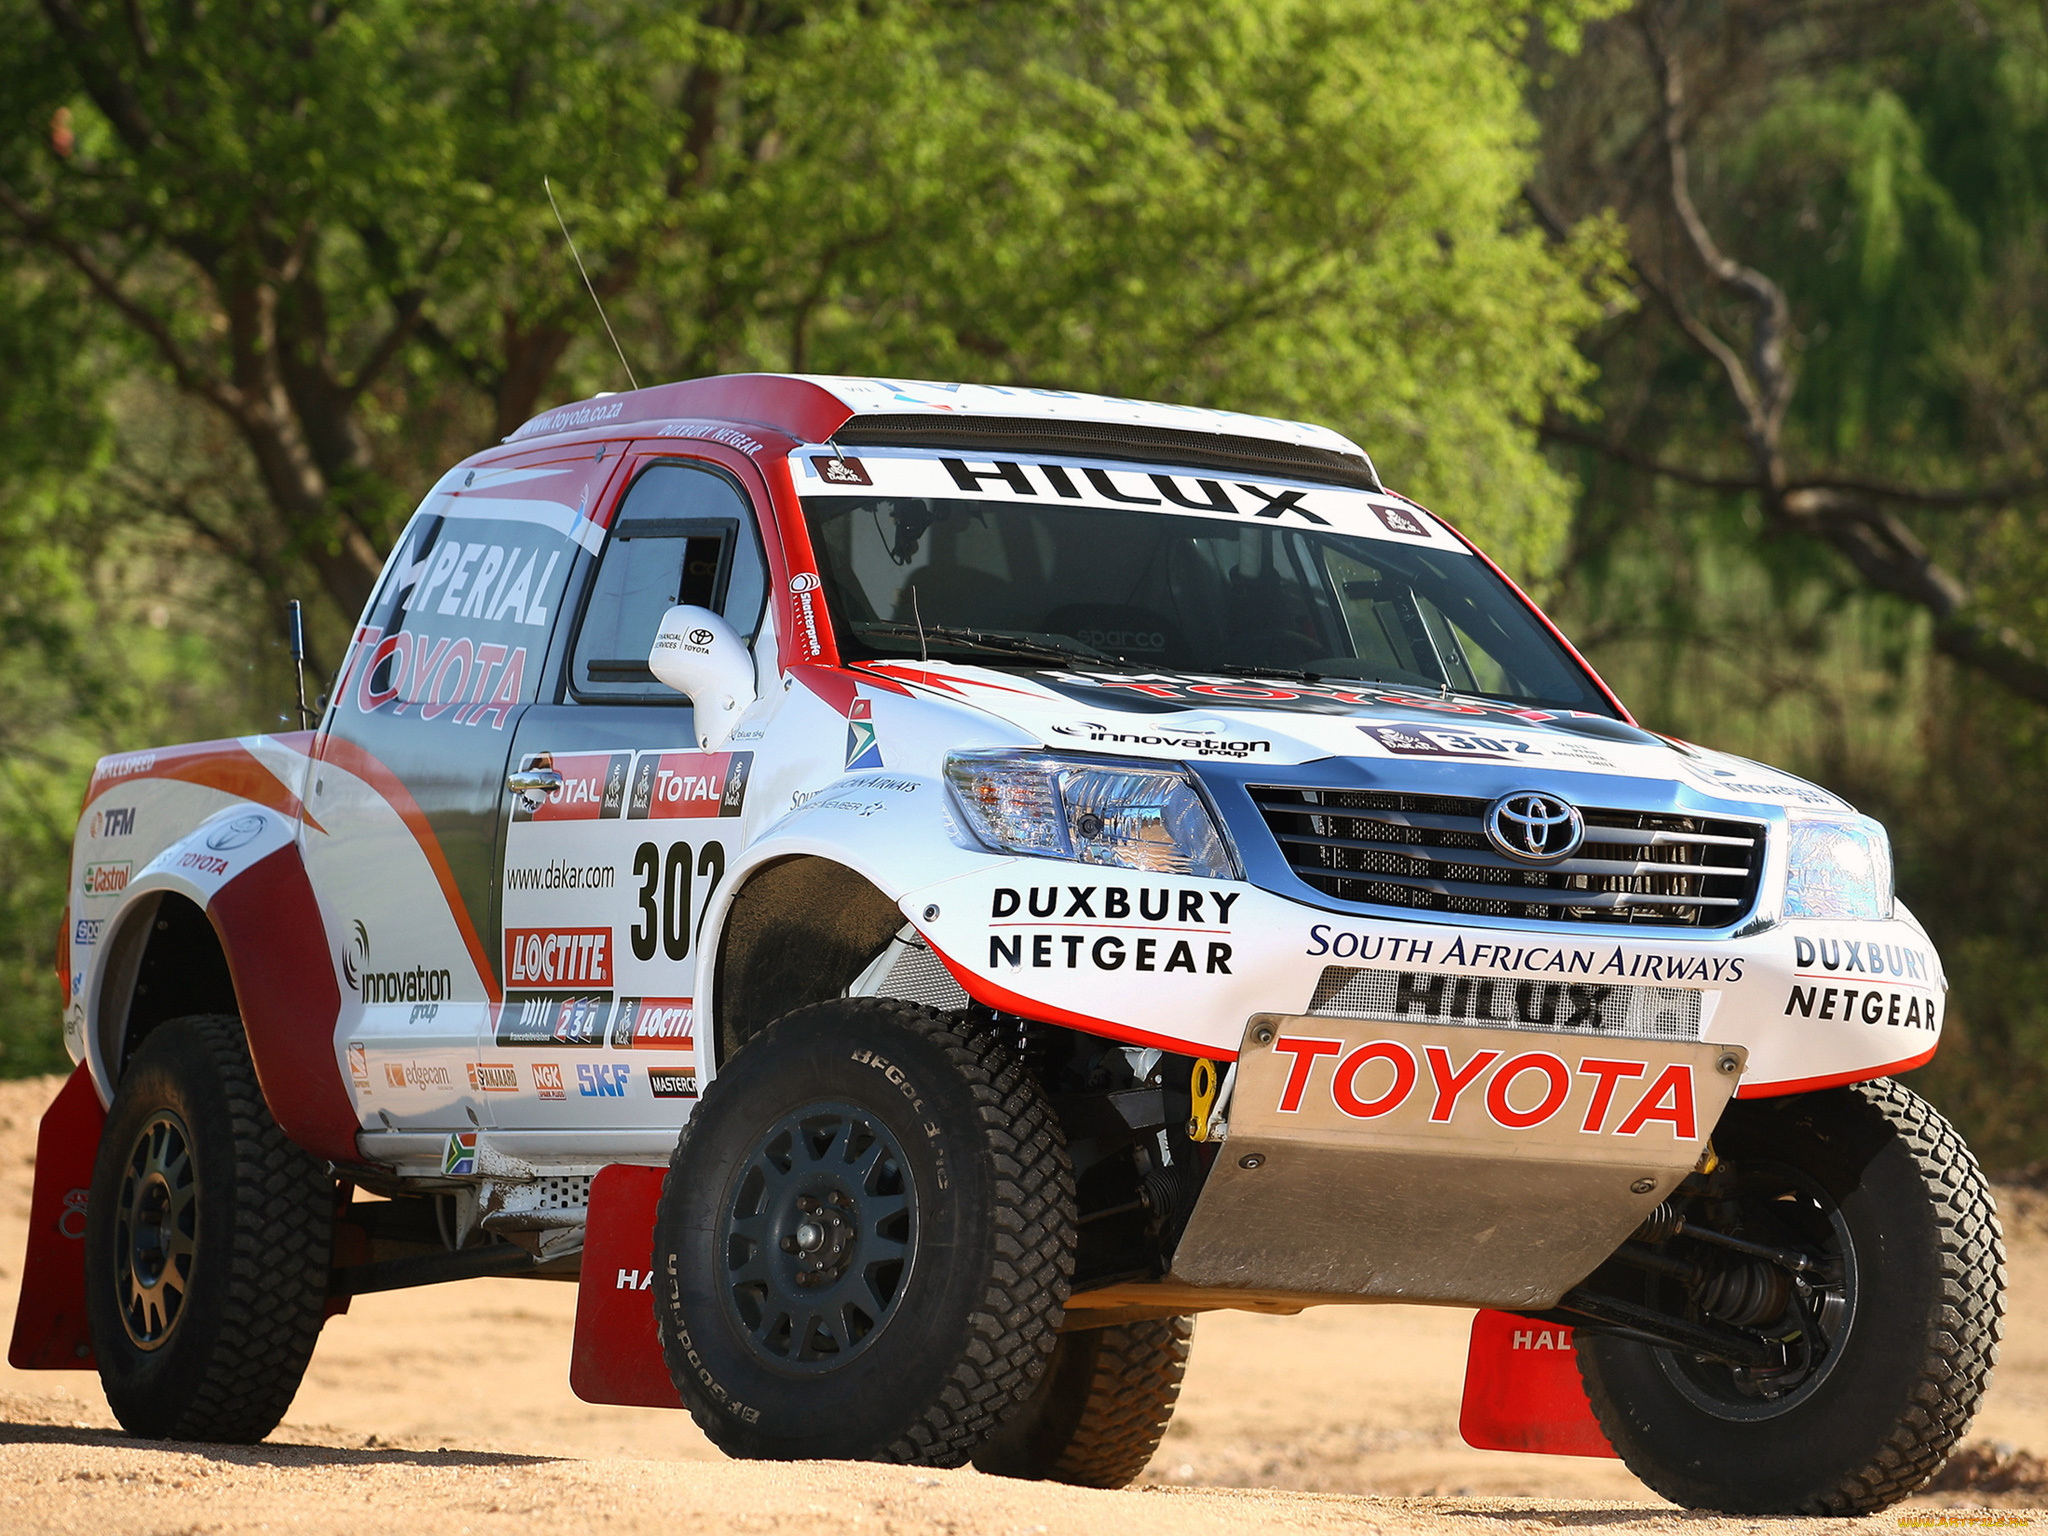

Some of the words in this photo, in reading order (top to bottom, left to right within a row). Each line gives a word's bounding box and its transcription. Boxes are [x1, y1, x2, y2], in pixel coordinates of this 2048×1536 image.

[523, 401, 623, 435] www.toyota.co.za
[657, 424, 714, 439] DUXBURY
[711, 427, 764, 456] NETGEAR
[938, 457, 1334, 527] HILUX
[684, 644, 710, 655] TOYOTA
[1077, 629, 1165, 648] sparco
[332, 623, 528, 731] TOYOTA
[1091, 732, 1272, 753] innovation
[1199, 748, 1249, 759] group
[1437, 734, 1544, 756] 302
[543, 778, 601, 804] OTAL
[657, 770, 720, 802] TOTAL
[104, 807, 136, 837] TFM
[93, 866, 129, 893] Castrol
[177, 852, 229, 876] TOYOTA
[507, 859, 615, 890] www.dakar.com
[991, 886, 1241, 924] DUXBURY
[988, 934, 1233, 975] NETGEAR
[1305, 924, 1431, 964] SOUTH
[1437, 933, 1595, 976] AFRICAN
[1598, 944, 1746, 983] AIRWAYS
[1793, 935, 1931, 983] DUXBURY
[361, 964, 451, 1004] innovation
[408, 1003, 439, 1025] group
[1394, 971, 1612, 1030] HILUX
[1783, 985, 1937, 1032] NETGEAR
[405, 1060, 450, 1091] edgecam
[532, 1066, 562, 1088] NGK
[576, 1064, 630, 1097] SKF
[1271, 1035, 1700, 1142] TOYOTA
